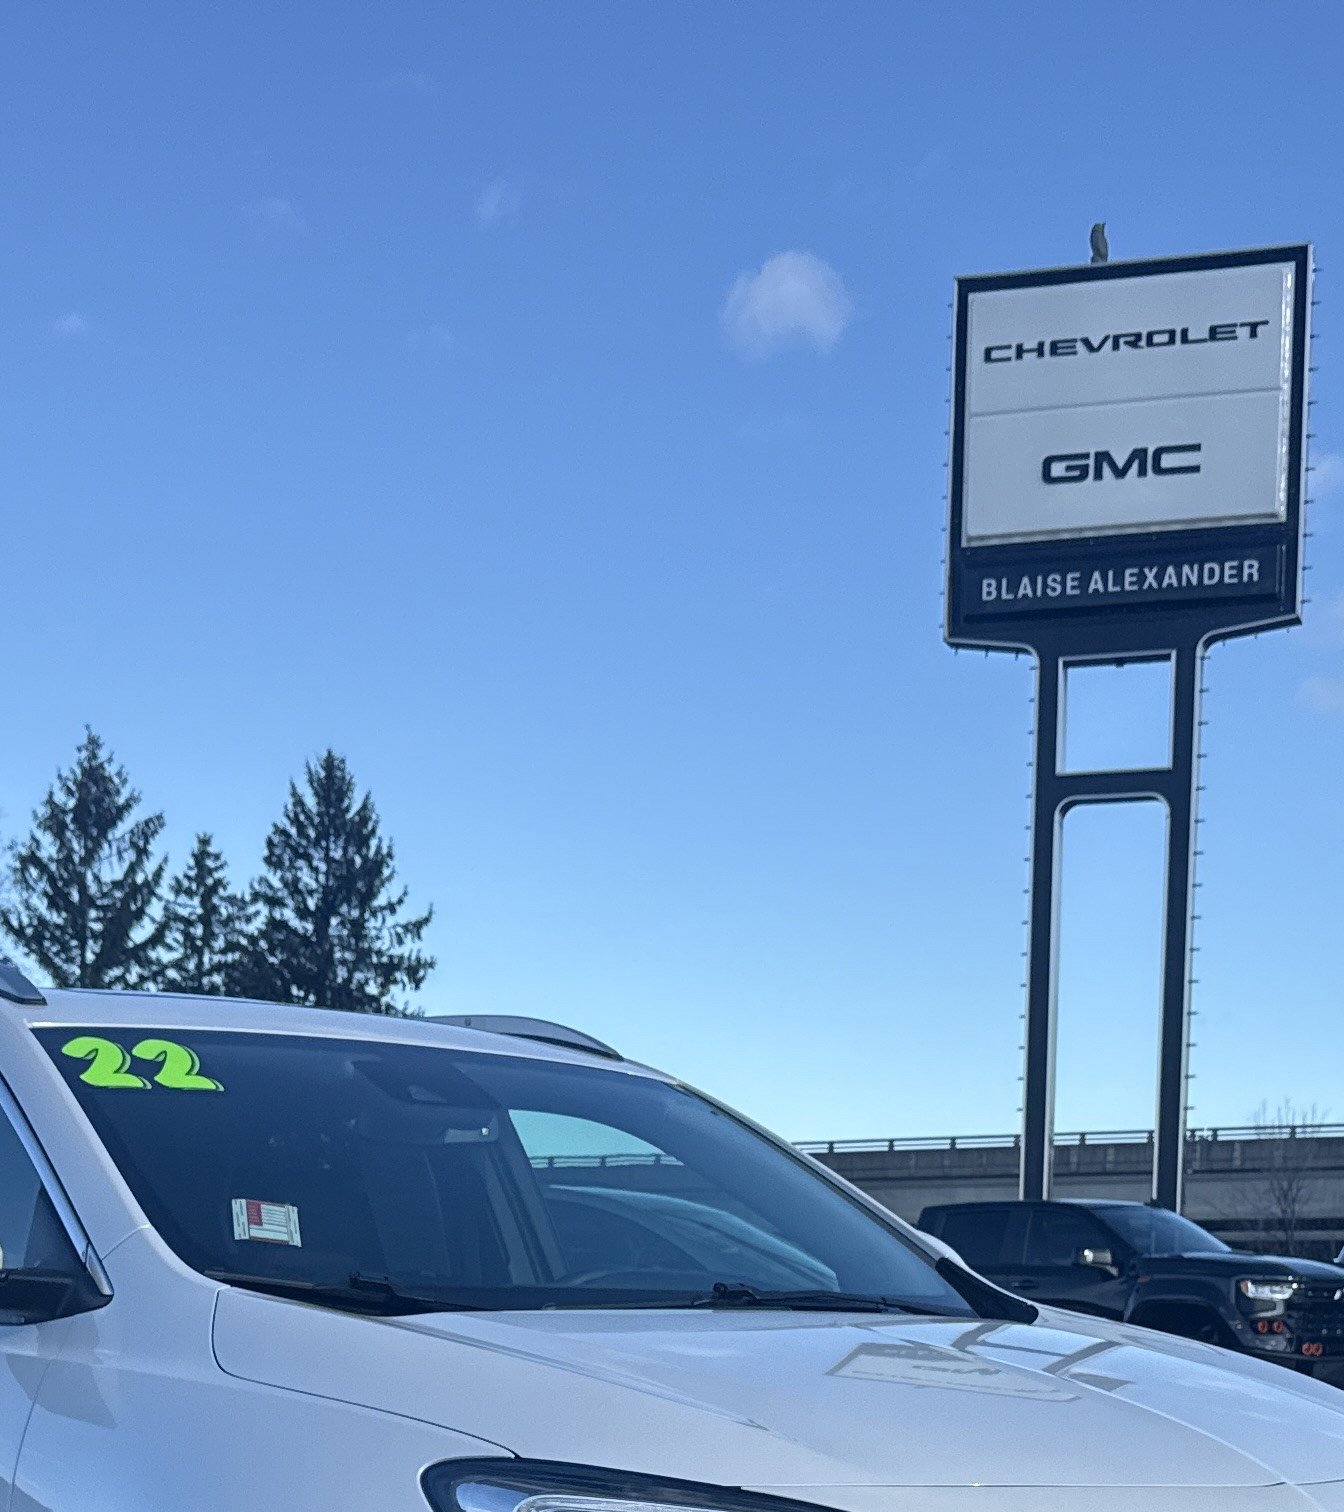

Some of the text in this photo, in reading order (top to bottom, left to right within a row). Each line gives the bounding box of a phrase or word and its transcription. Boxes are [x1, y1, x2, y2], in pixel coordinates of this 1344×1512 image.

[983, 320, 1269, 363] CHEVROLET
[1041, 443, 1202, 485] GMC
[981, 559, 1260, 601] BLAISE ALEXANDER
[61, 1036, 225, 1091] 22
